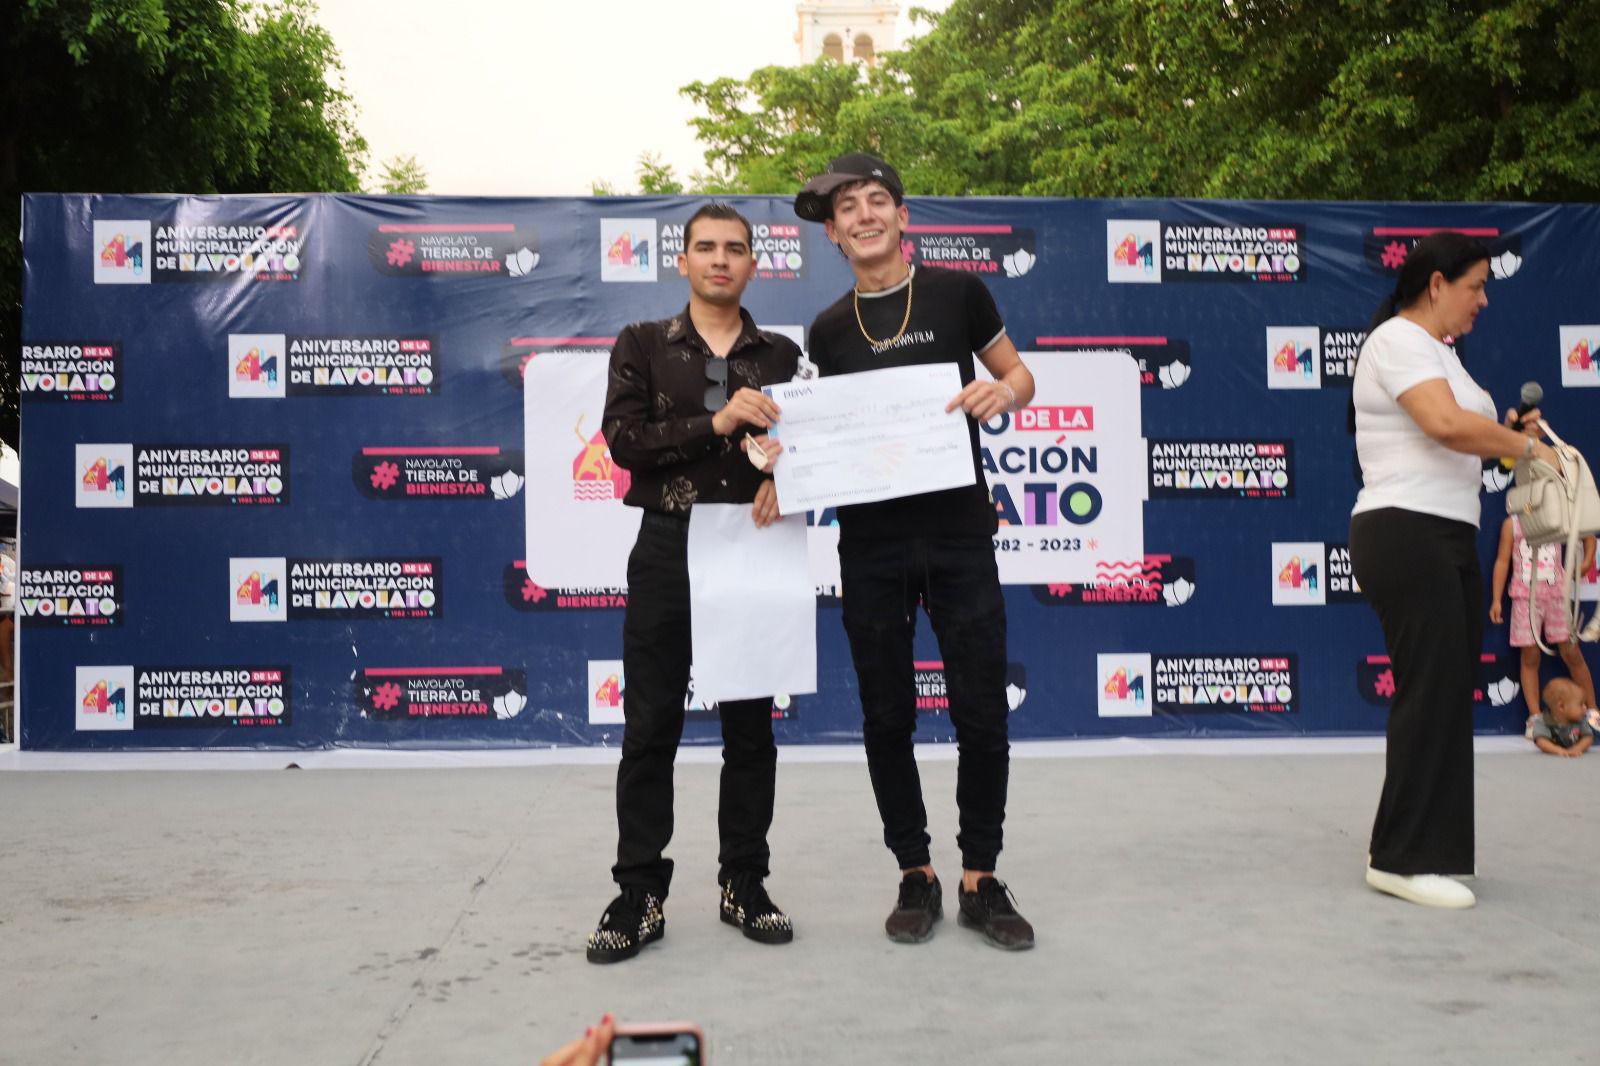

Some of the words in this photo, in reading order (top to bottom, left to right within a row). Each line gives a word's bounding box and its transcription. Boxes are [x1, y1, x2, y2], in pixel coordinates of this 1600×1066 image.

[155, 226, 266, 239] ANIVERSARIO
[1165, 226, 1268, 241] ANIVERSARIO
[421, 236, 477, 246] NAVOLATO
[921, 237, 975, 247] NAVOLATO
[421, 247, 470, 259] TIERRA
[474, 247, 493, 259] DE
[921, 248, 969, 260] TIERRA
[972, 248, 991, 260] DE
[156, 257, 176, 269] DE
[179, 254, 300, 271] NAVOLATO
[421, 260, 501, 272] BIENESTAR
[1166, 256, 1185, 270] DE
[1187, 254, 1299, 272] NAVOLATO
[290, 340, 400, 353] ANIVERSARIO
[1326, 362, 1344, 375] DE
[291, 371, 311, 383] DE
[314, 367, 433, 385] NAVOLATO
[1021, 410, 1050, 428] DE
[1058, 410, 1088, 428] LA
[138, 450, 249, 463] ANIVERSARIO
[1152, 444, 1256, 457] ANIVERSARIO
[405, 459, 462, 468] NAVOLATO
[405, 470, 455, 482] TIERRA
[459, 470, 478, 482] DE
[1153, 473, 1172, 487] DE
[1175, 471, 1288, 489] NAVOLATO
[139, 481, 159, 493] DE
[162, 477, 282, 495] NAVOLATO
[406, 483, 486, 495] BIENESTAR
[990, 482, 1103, 525] ATO
[993, 539, 1020, 551] 982
[1040, 539, 1081, 551] 2023
[291, 563, 402, 577] ANIVERSARIO
[1331, 578, 1349, 591] DE
[292, 594, 312, 607] DE
[315, 590, 435, 608] NAVOLATO
[557, 596, 628, 608] BIENESTA
[1156, 658, 1259, 672] ANIVERSARIO
[138, 671, 250, 685] ANIVERSARIO
[408, 680, 465, 689] NAVOLATO
[408, 690, 457, 702] TIERRA
[462, 690, 480, 702] DE
[1157, 689, 1176, 702] DE
[1179, 685, 1292, 703] NAVOLATO
[140, 703, 160, 715] DE
[163, 698, 284, 717] NAVOLATO
[409, 703, 488, 715] BIENESTAR
